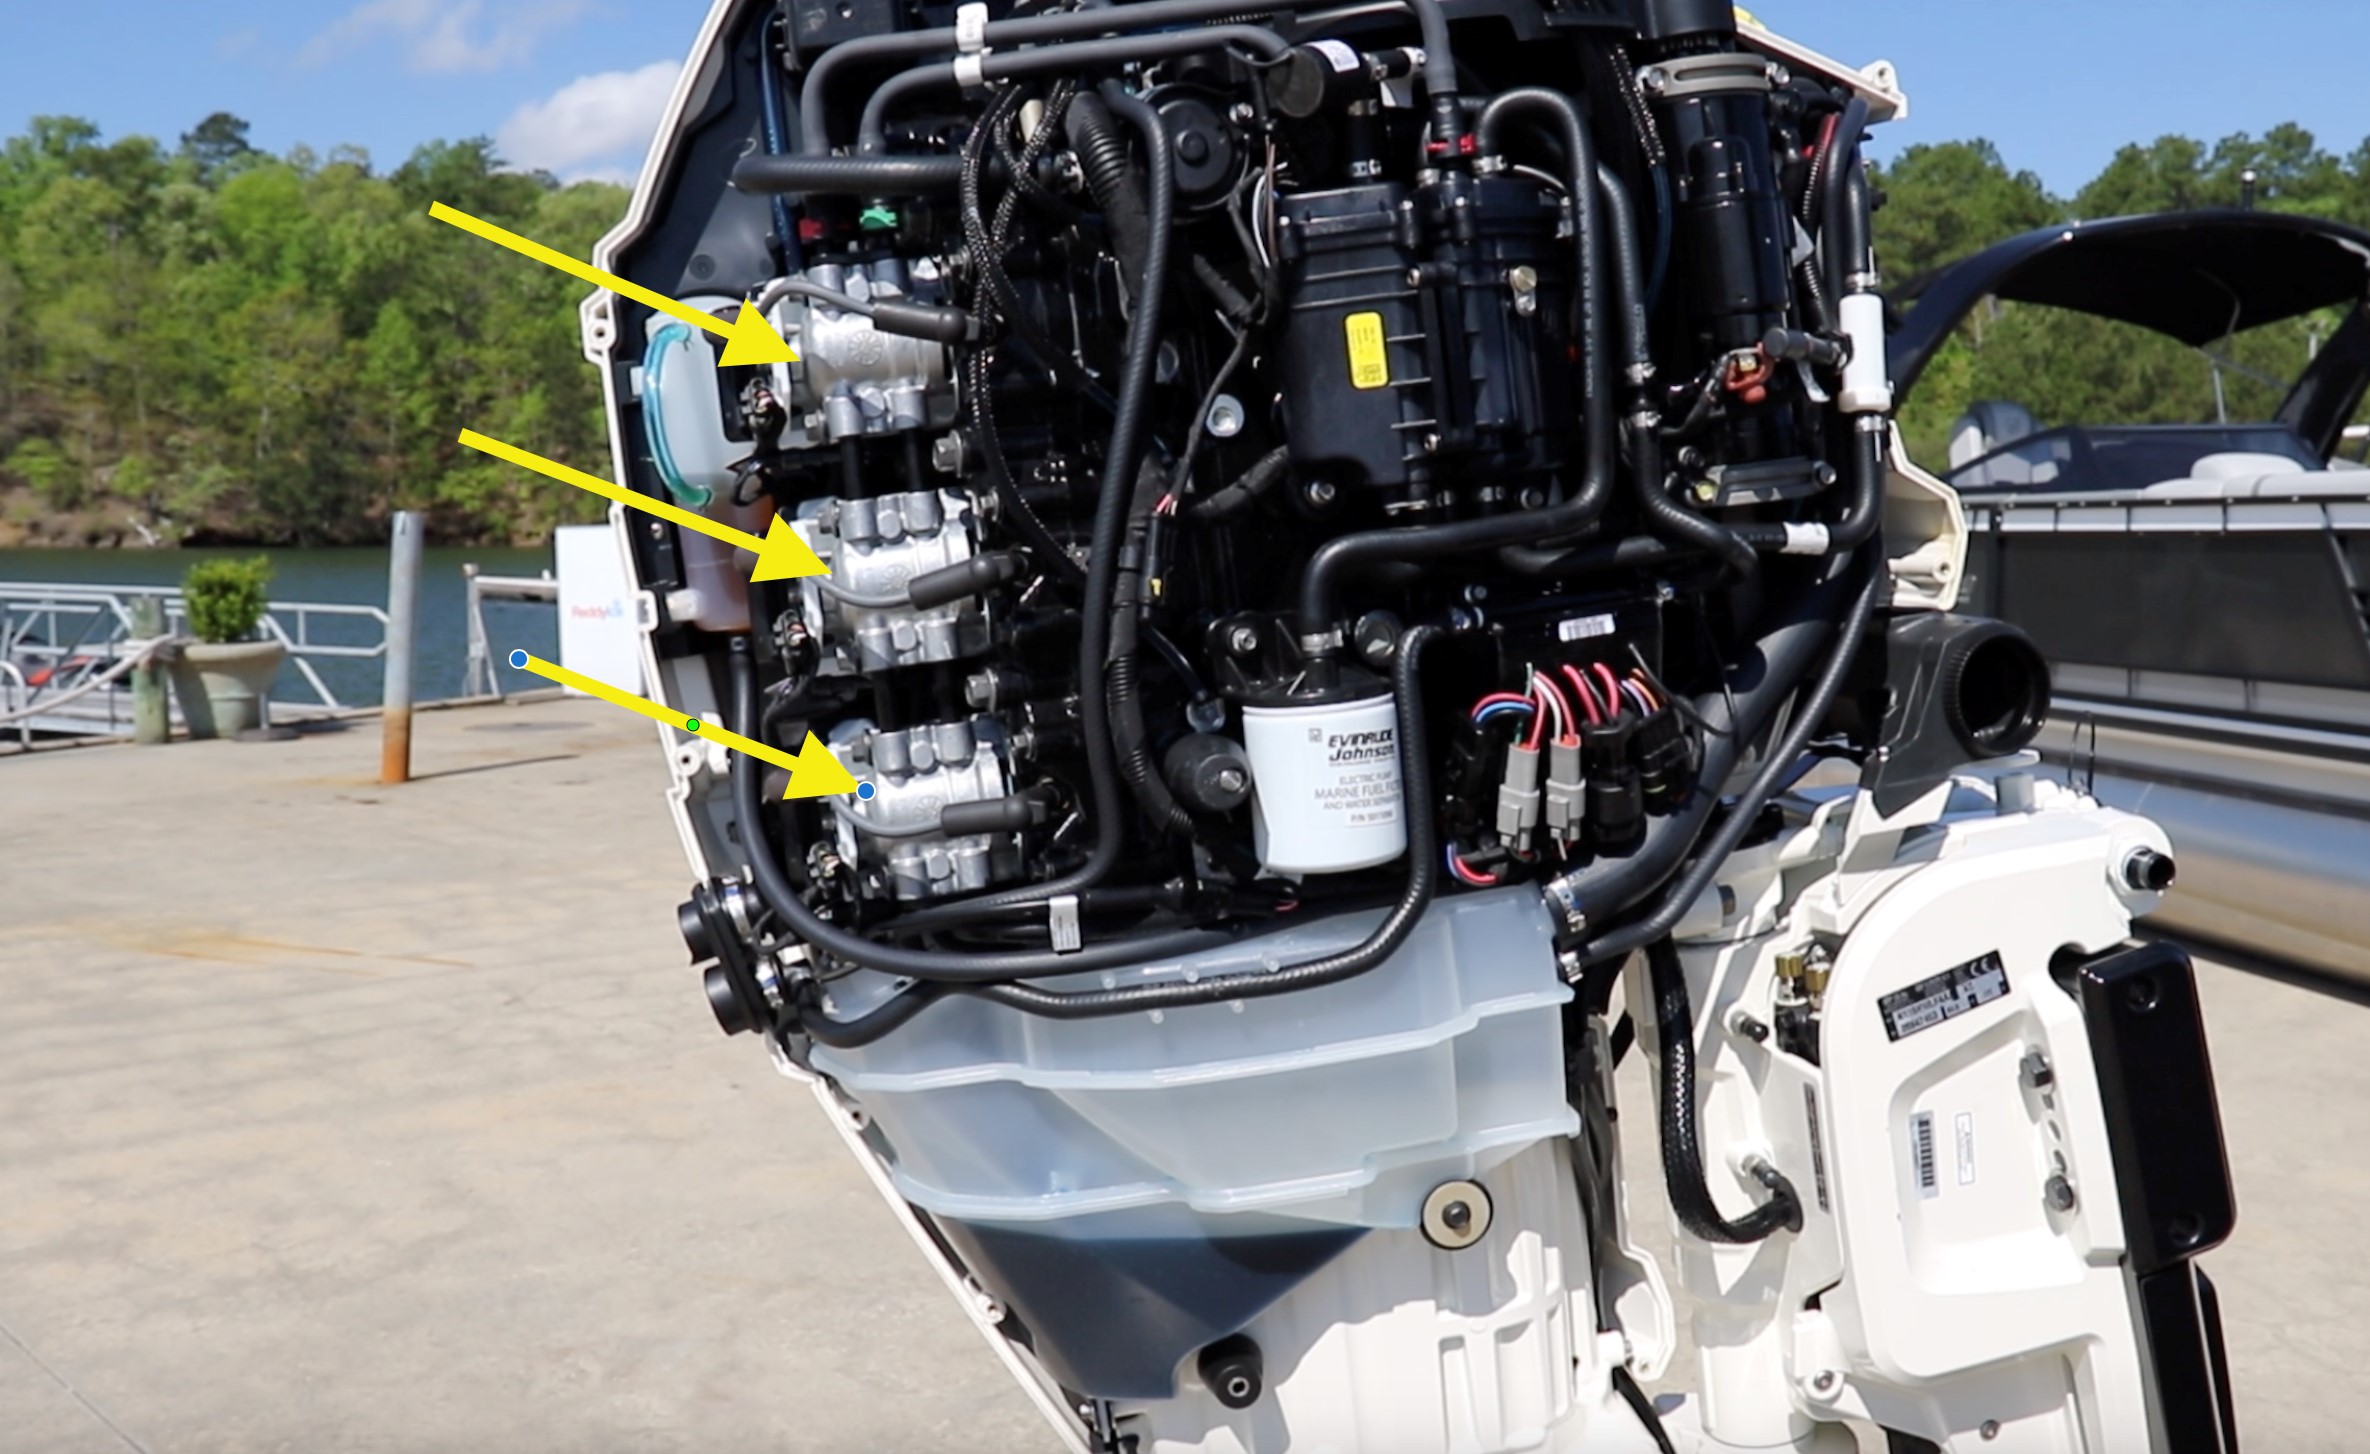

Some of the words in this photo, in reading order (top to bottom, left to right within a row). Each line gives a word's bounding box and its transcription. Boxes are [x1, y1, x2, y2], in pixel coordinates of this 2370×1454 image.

[1328, 728, 1393, 748] EVINRUDE
[1329, 744, 1395, 762] Johnson
[1314, 786, 1360, 799] MARINE
